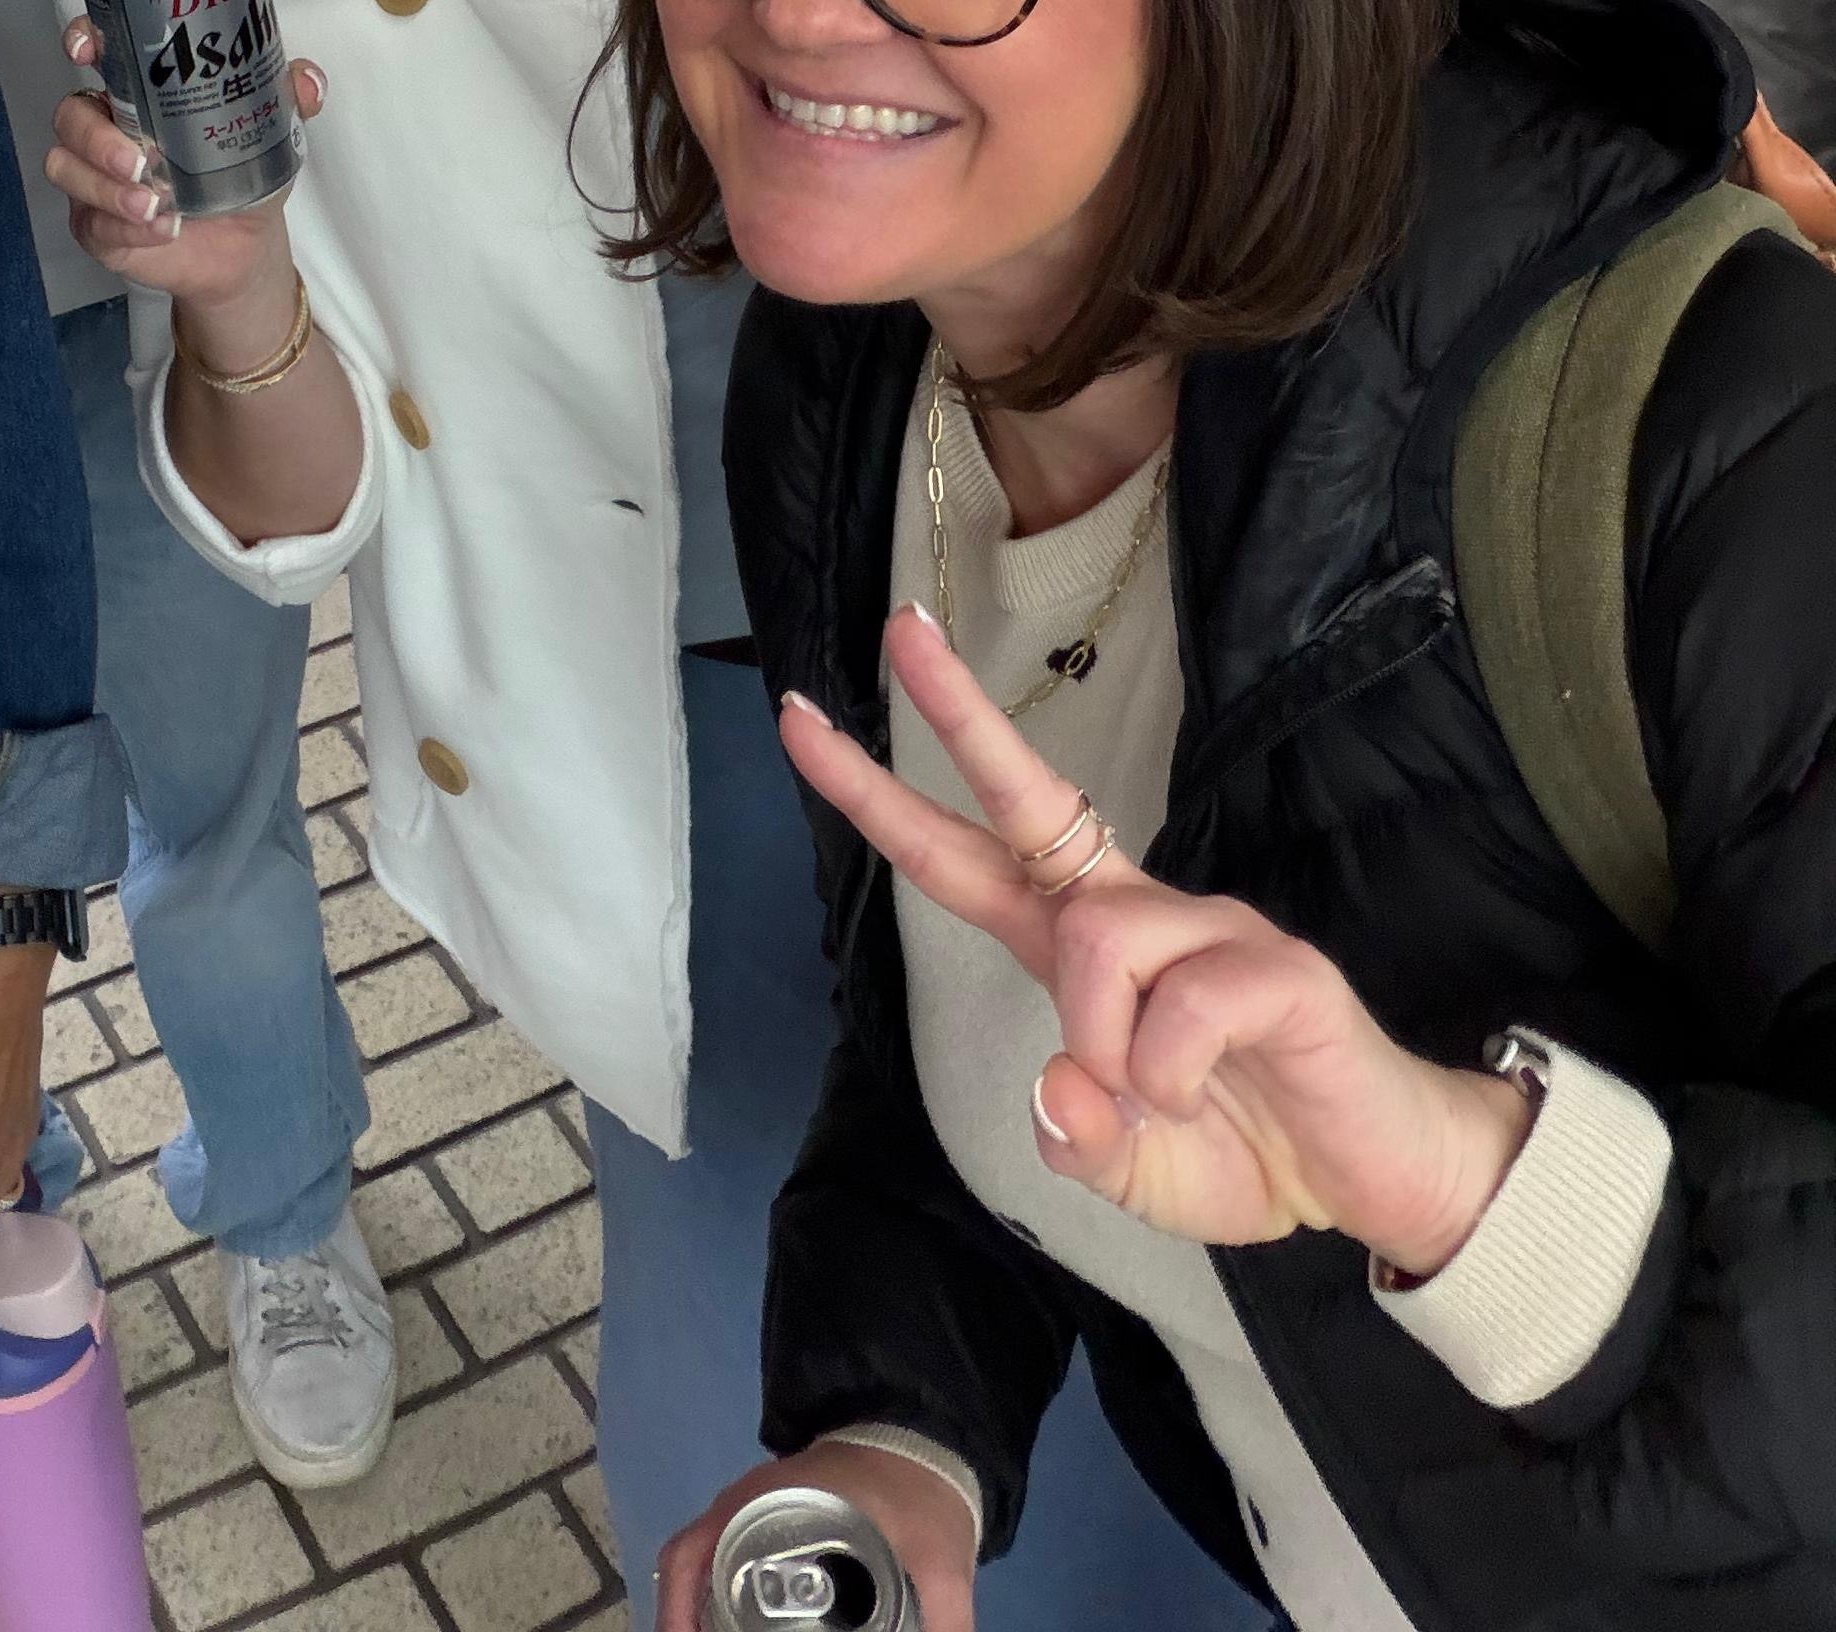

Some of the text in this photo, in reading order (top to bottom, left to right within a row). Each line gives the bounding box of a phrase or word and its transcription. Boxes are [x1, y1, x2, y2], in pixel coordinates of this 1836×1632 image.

[223, 73, 256, 104] 生
[204, 95, 280, 140] スーパードライ
